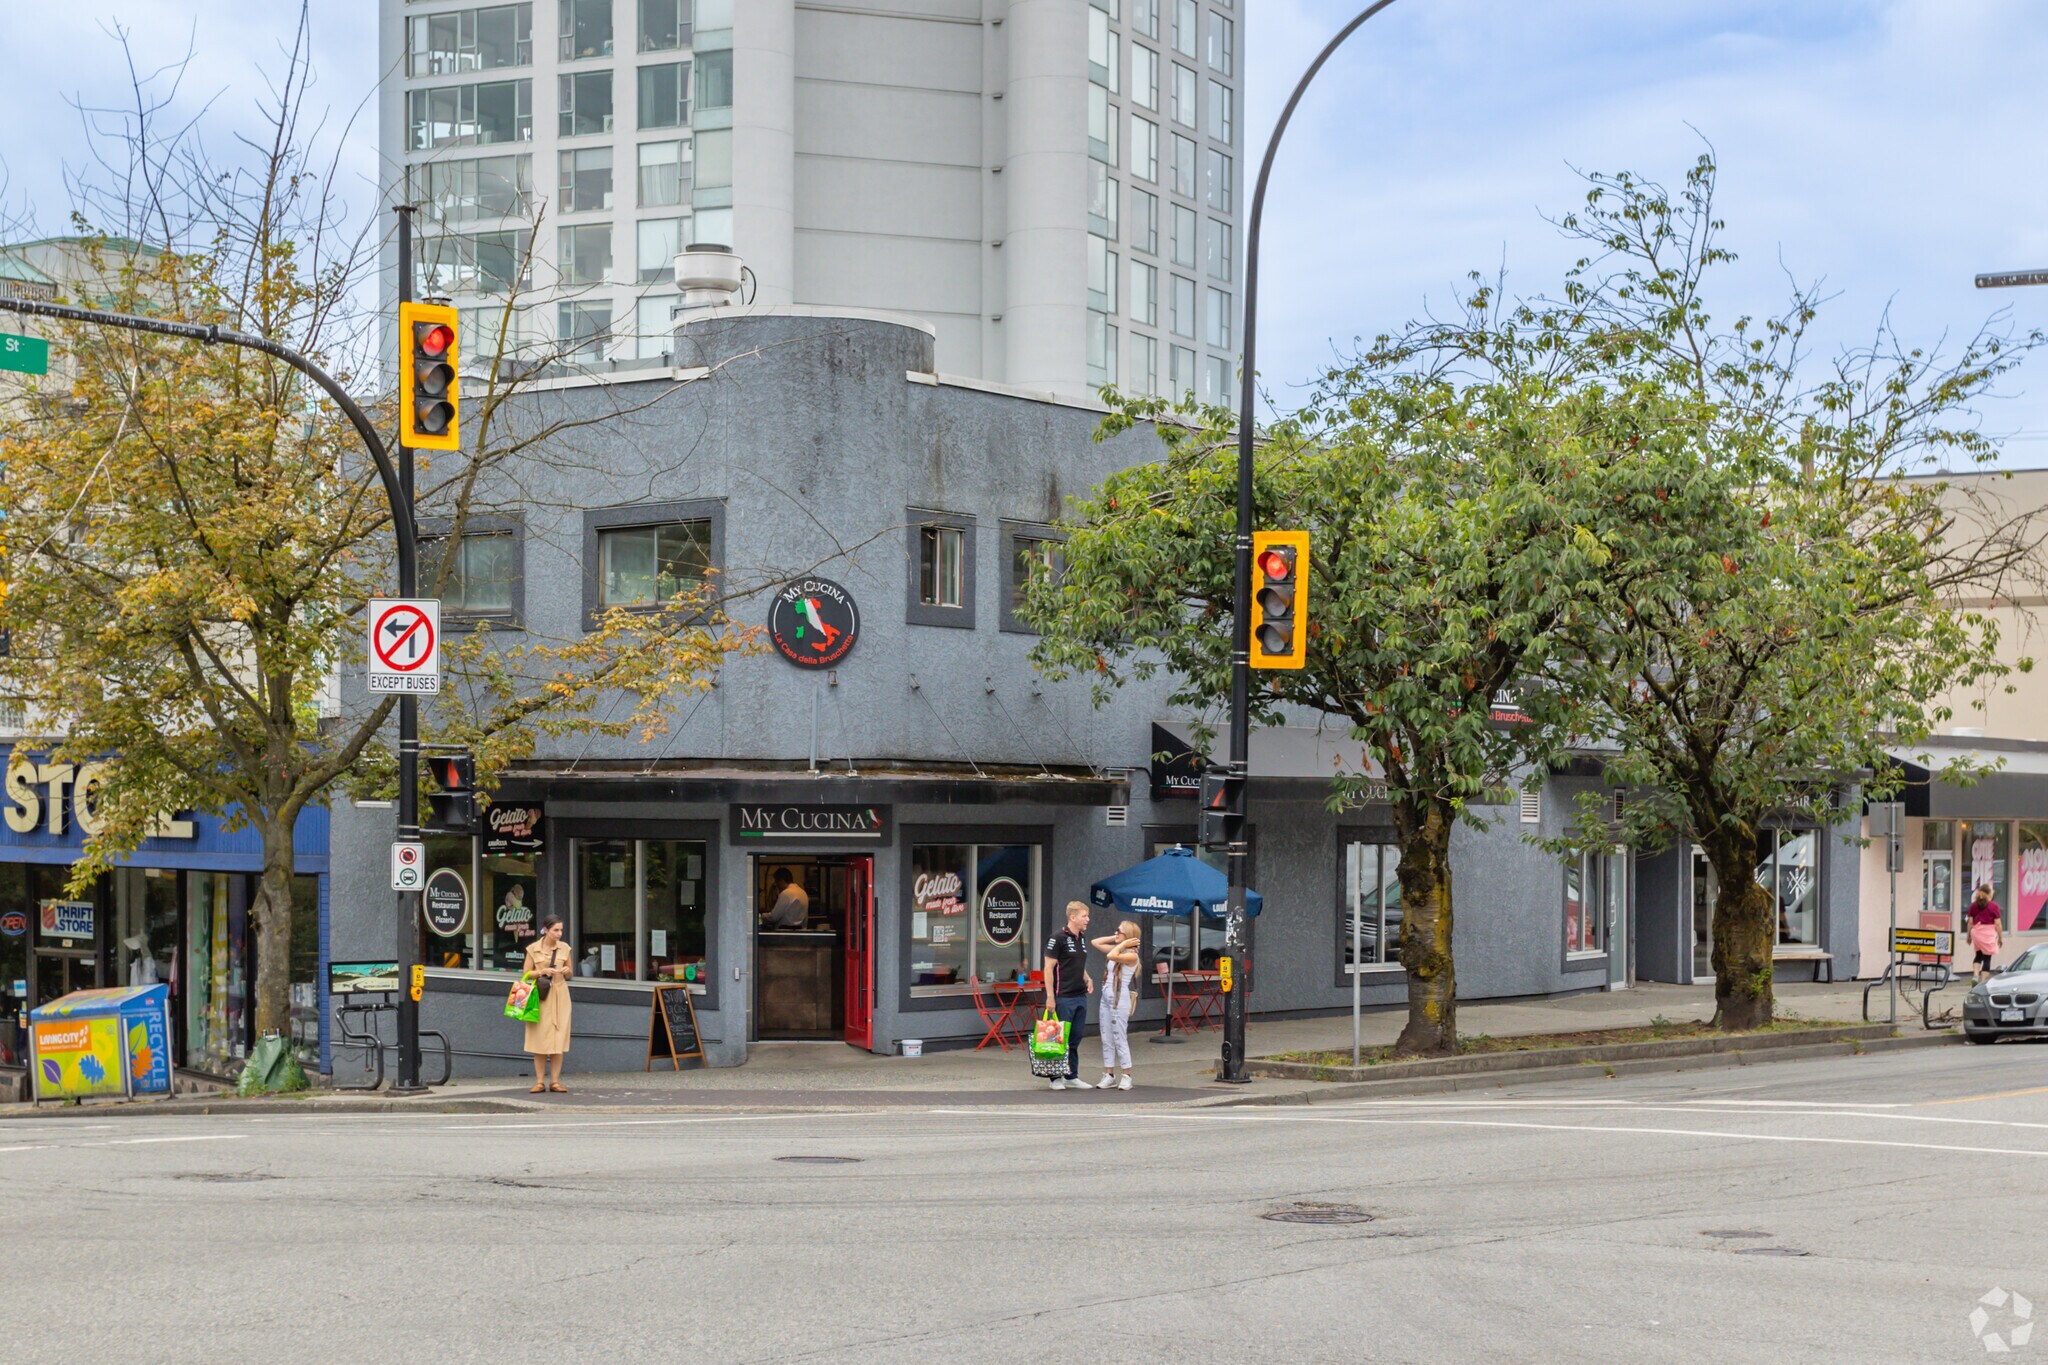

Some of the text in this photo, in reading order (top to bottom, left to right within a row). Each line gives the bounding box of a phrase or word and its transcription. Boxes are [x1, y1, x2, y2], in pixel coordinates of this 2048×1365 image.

[5, 337, 20, 352] St
[783, 580, 845, 604] MY CUCINA
[781, 643, 798, 659] Casa
[798, 656, 817, 665] della
[819, 634, 854, 664] Bruschetta
[371, 676, 436, 690] EXCEPT BUSES
[1165, 775, 1180, 785] MY
[490, 808, 528, 830] Gelato
[741, 807, 868, 830] MY CUCINA
[1971, 860, 1994, 890] PIE
[914, 873, 961, 905] Gelato
[2021, 870, 2048, 897] OPE
[431, 901, 460, 910] Restaurant
[1130, 896, 1174, 910] LAVAZZA
[57, 905, 93, 920] THRIFT
[435, 915, 456, 924] Pizzeria
[442, 909, 448, 917] &
[496, 905, 533, 928] Gelato
[988, 911, 1018, 919] Restaurant
[1, 916, 27, 930] OPEN
[59, 920, 93, 933] STORE
[991, 926, 1012, 934] Pizzeria
[999, 919, 1005, 927] &
[1895, 937, 1924, 945] mployment
[62, 1032, 79, 1044] CITY
[149, 1011, 167, 1089] RECYCLE
